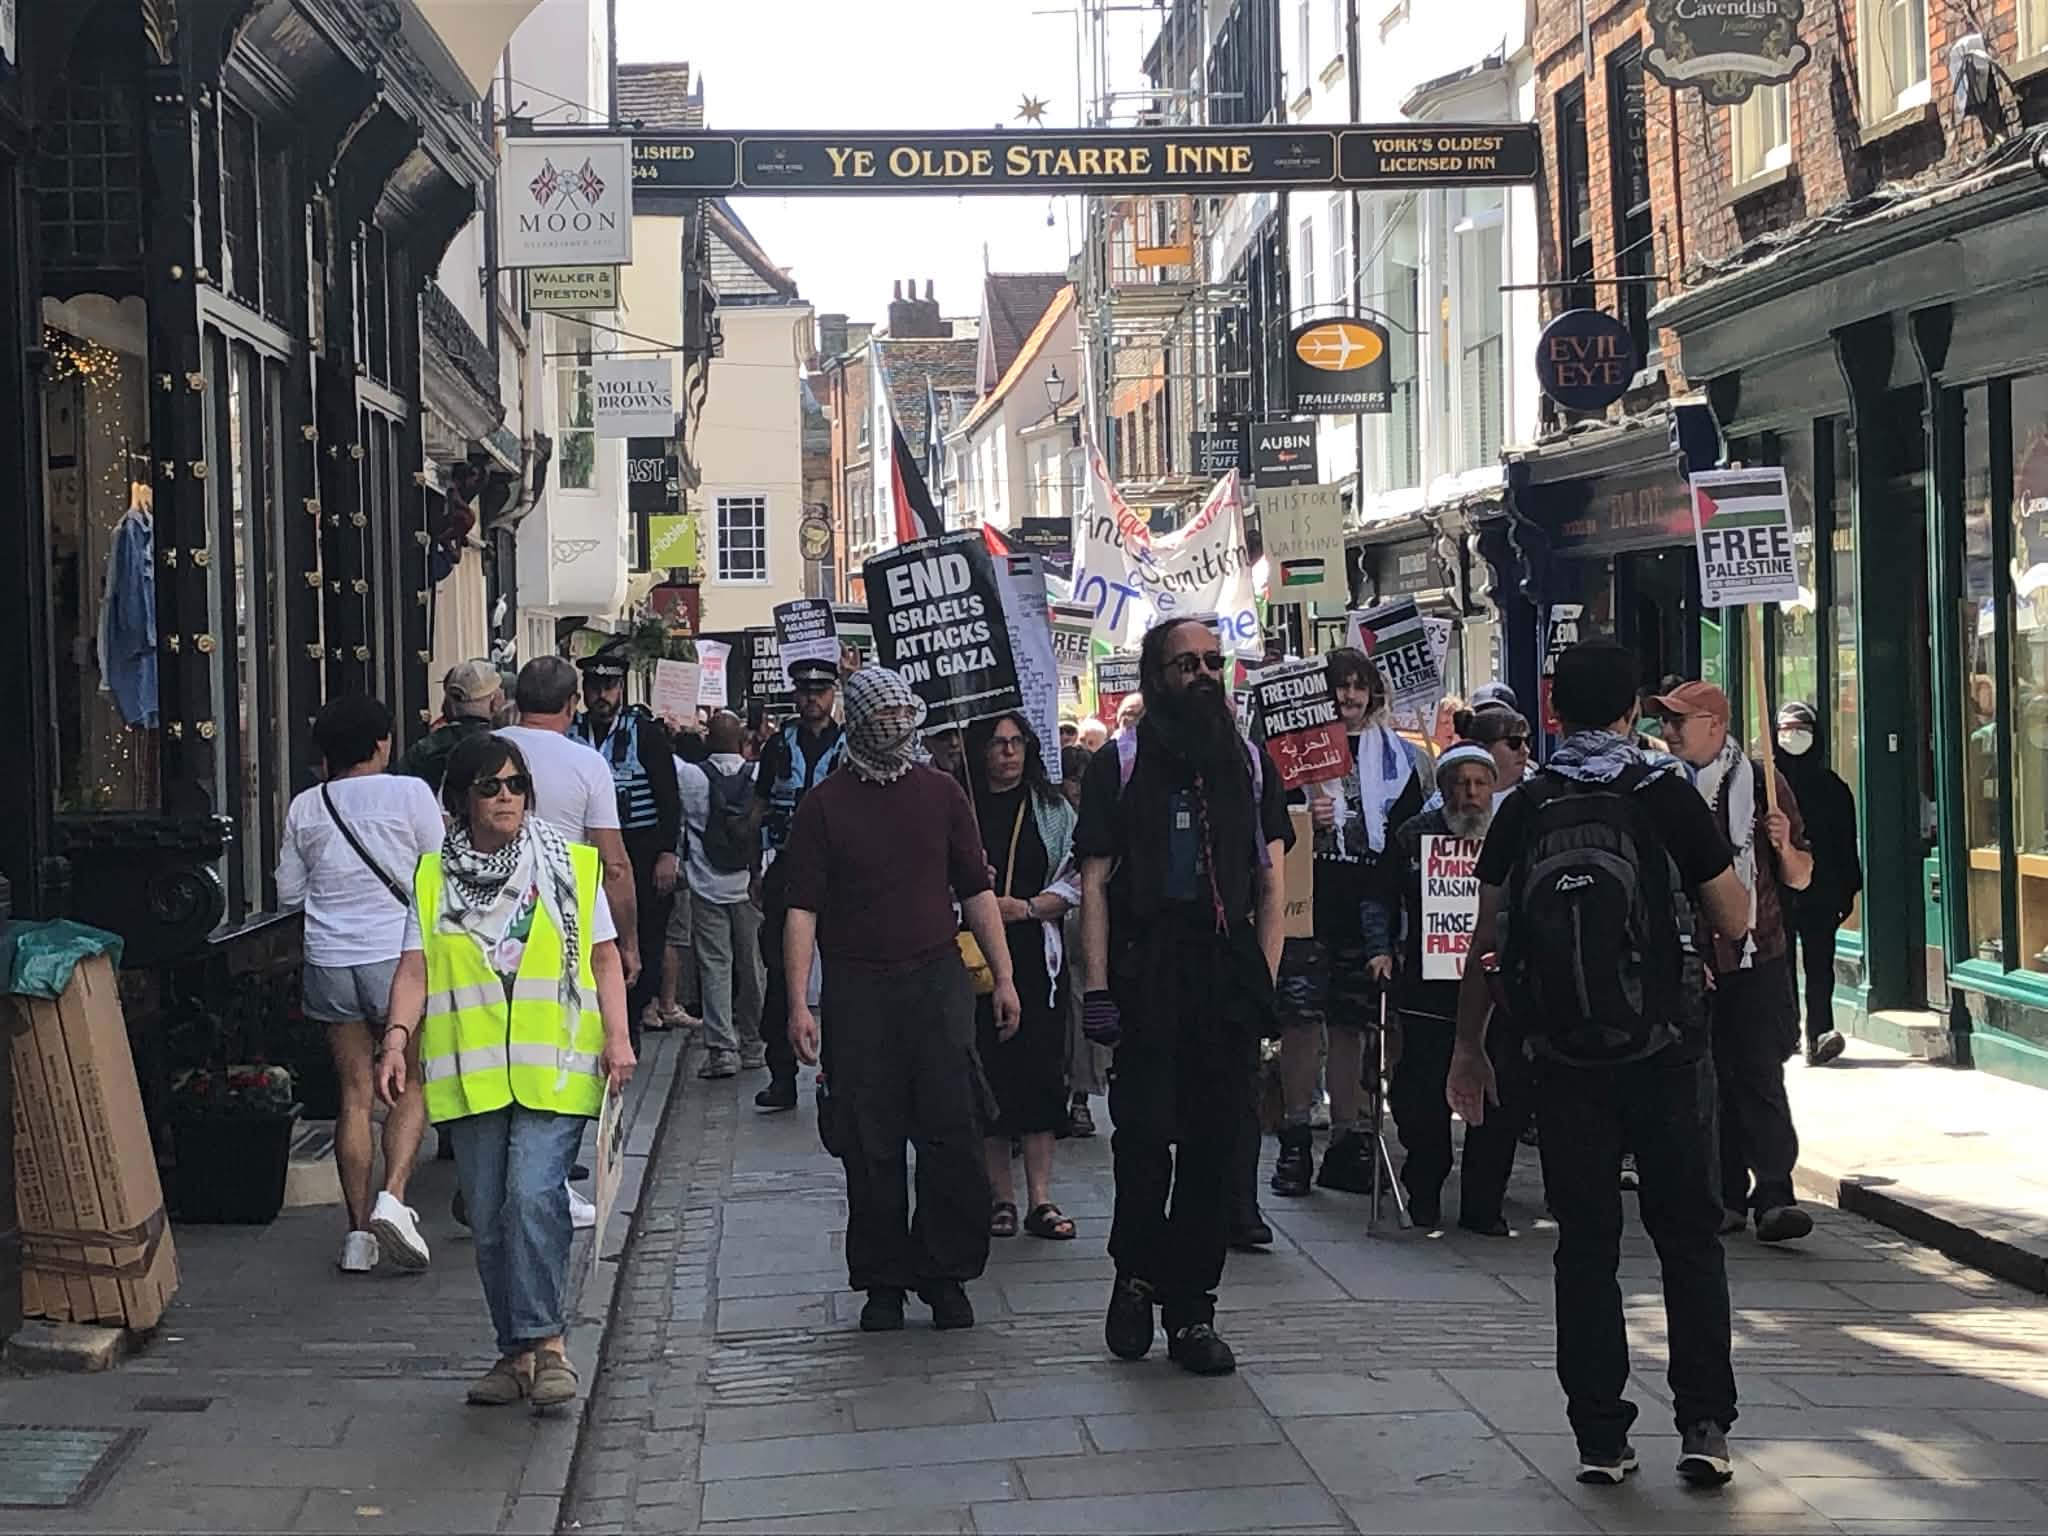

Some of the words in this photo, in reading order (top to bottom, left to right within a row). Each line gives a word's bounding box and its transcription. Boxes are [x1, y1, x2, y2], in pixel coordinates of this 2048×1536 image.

[1676, 0, 1777, 19] Cavendish
[632, 146, 695, 160] LISHED
[1372, 138, 1433, 153] YORK'S
[1437, 136, 1503, 151] OLDEST
[825, 147, 876, 177] YE
[889, 146, 994, 178] OLDE
[1006, 145, 1152, 176] STARRE
[1165, 144, 1254, 174] INNE
[1380, 157, 1462, 172] LICENSED
[1467, 156, 1496, 170] INN
[519, 211, 616, 233] MOON
[533, 271, 595, 284] WALKER
[599, 271, 609, 282] &
[532, 288, 613, 300] PRESTON'S
[1549, 335, 1630, 361] EVIL
[1556, 361, 1625, 387] EYE
[598, 380, 657, 394] MOLLY
[1297, 391, 1385, 404] TRAILFINDERS
[598, 395, 672, 409] BROWNS
[1200, 439, 1239, 450] WHITE
[1260, 434, 1311, 450] AUBIN
[1200, 456, 1238, 467] STUFF
[1267, 490, 1338, 514] HISTORY
[1290, 515, 1312, 534] IS
[1702, 526, 1791, 562] FREE
[1705, 558, 1793, 579] PALESTINE
[885, 553, 972, 608] END
[888, 595, 985, 634] ISRAEL'S
[753, 636, 778, 657] EN
[895, 620, 991, 660] ATTACKS
[1052, 632, 1090, 652] REE
[752, 657, 780, 669] ISRAE
[900, 659, 931, 686] ON
[936, 646, 997, 678] GAZA
[752, 670, 783, 682] ATTAC
[1392, 666, 1438, 690] LESTINE
[1260, 671, 1328, 706] FREEDOM
[1264, 700, 1338, 737] PALESTINE
[1280, 731, 1331, 758] الحرية
[1430, 836, 1482, 857] ACTIV
[1427, 857, 1475, 878] PUNIS
[1428, 878, 1478, 897] RAISIN
[1426, 911, 1474, 934] THOSE
